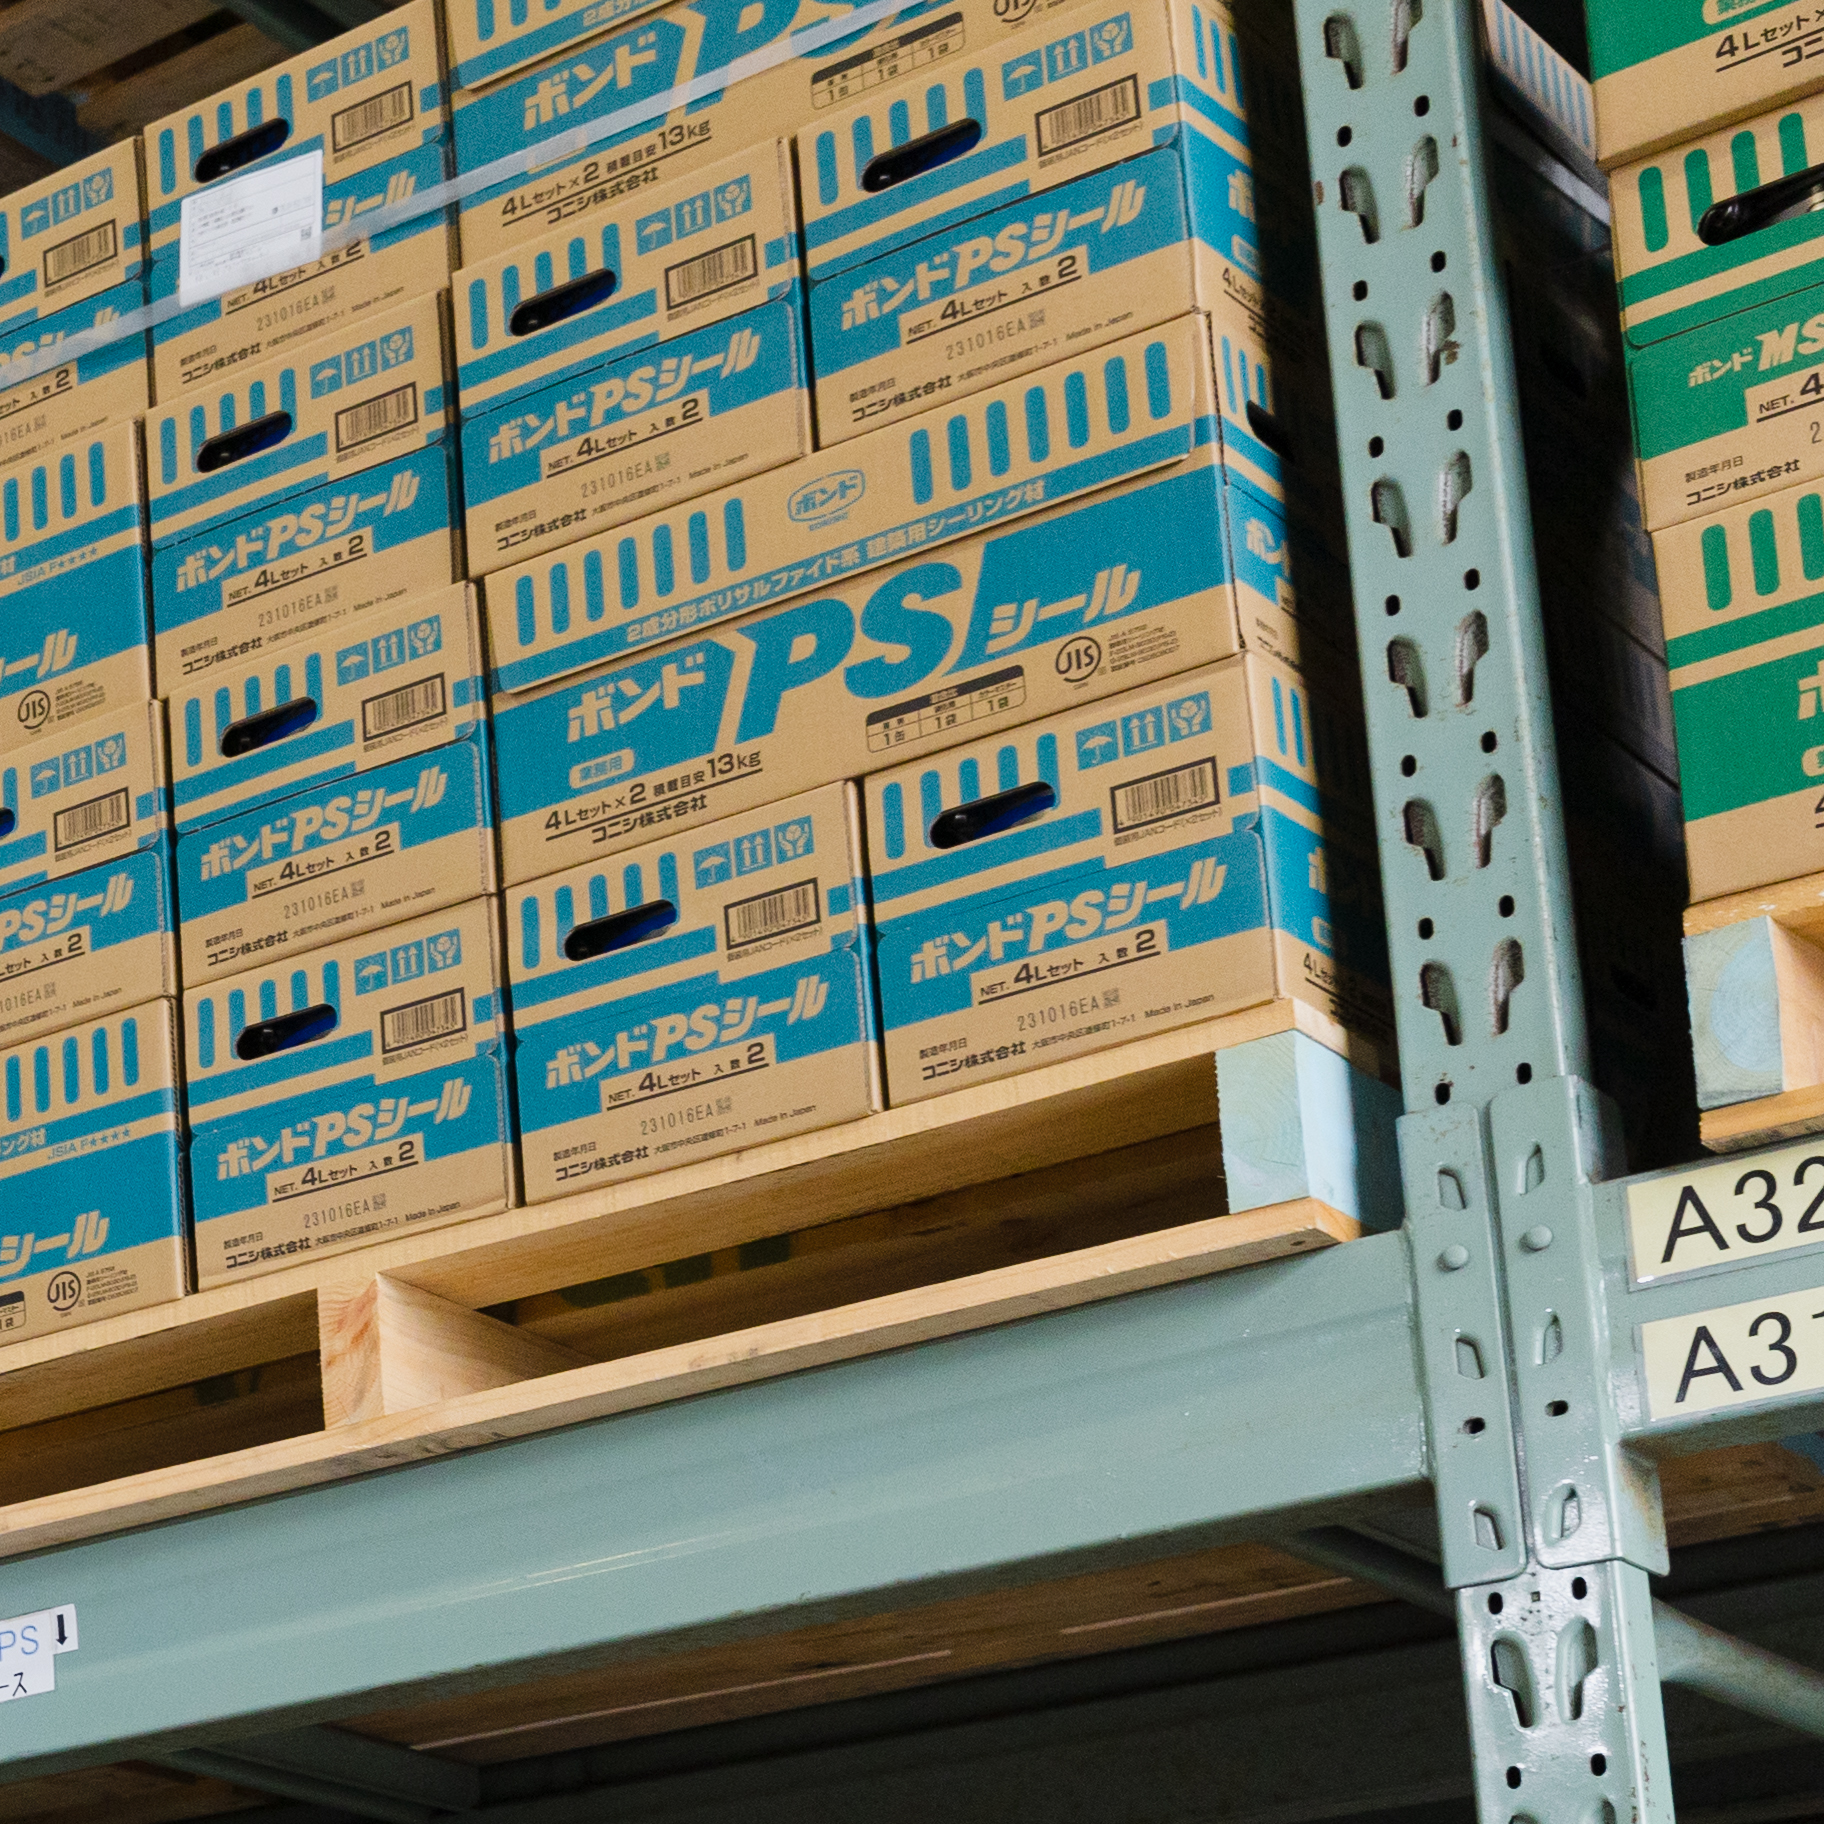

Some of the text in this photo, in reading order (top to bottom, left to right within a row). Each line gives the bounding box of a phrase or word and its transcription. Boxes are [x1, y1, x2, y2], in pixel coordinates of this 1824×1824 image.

[1687, 459, 1800, 506] コニシ株式会社
[566, 652, 706, 743] ボンド
[734, 561, 963, 745] PS
[986, 562, 1142, 654] シール
[922, 1042, 1026, 1080] コニシ株式会社
[1675, 1312, 1824, 1404] A3
